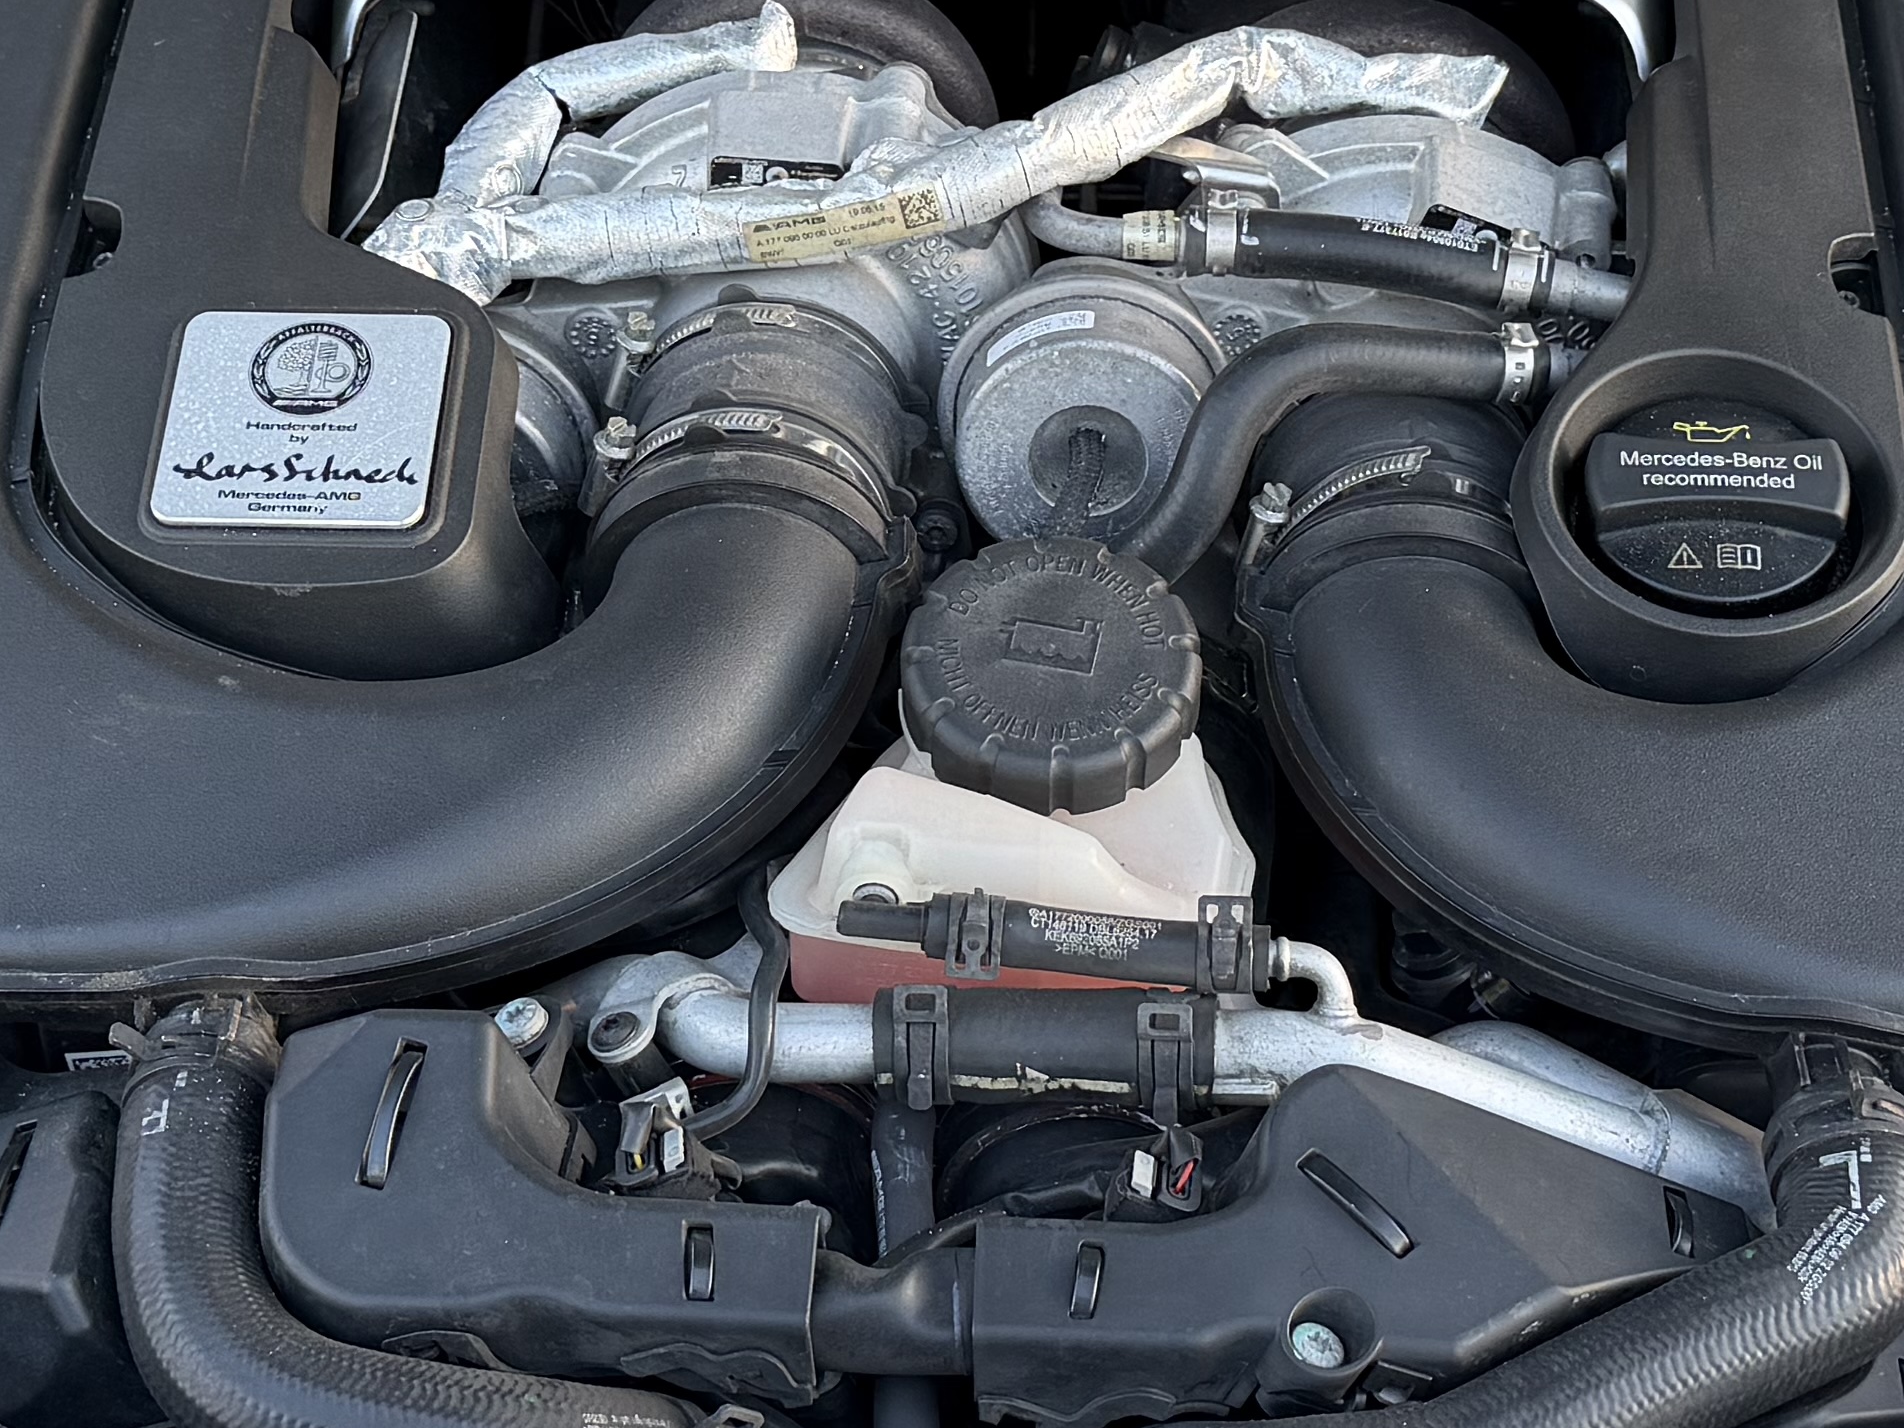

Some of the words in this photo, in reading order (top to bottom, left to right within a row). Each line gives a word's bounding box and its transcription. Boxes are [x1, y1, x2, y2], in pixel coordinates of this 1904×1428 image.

[245, 421, 358, 432] Handcrafted
[288, 434, 309, 445] by
[1619, 450, 1788, 470] Mercedes-Benz
[1793, 453, 1823, 471] Oil
[1641, 472, 1796, 490] recommended
[217, 489, 362, 502] Mercedes-AMG
[247, 501, 329, 515] Germany
[948, 588, 979, 616] DO
[975, 560, 1017, 593] NOT
[1025, 555, 1087, 576] OPEN
[1091, 563, 1150, 613] WHEN
[1135, 611, 1167, 650] HOT
